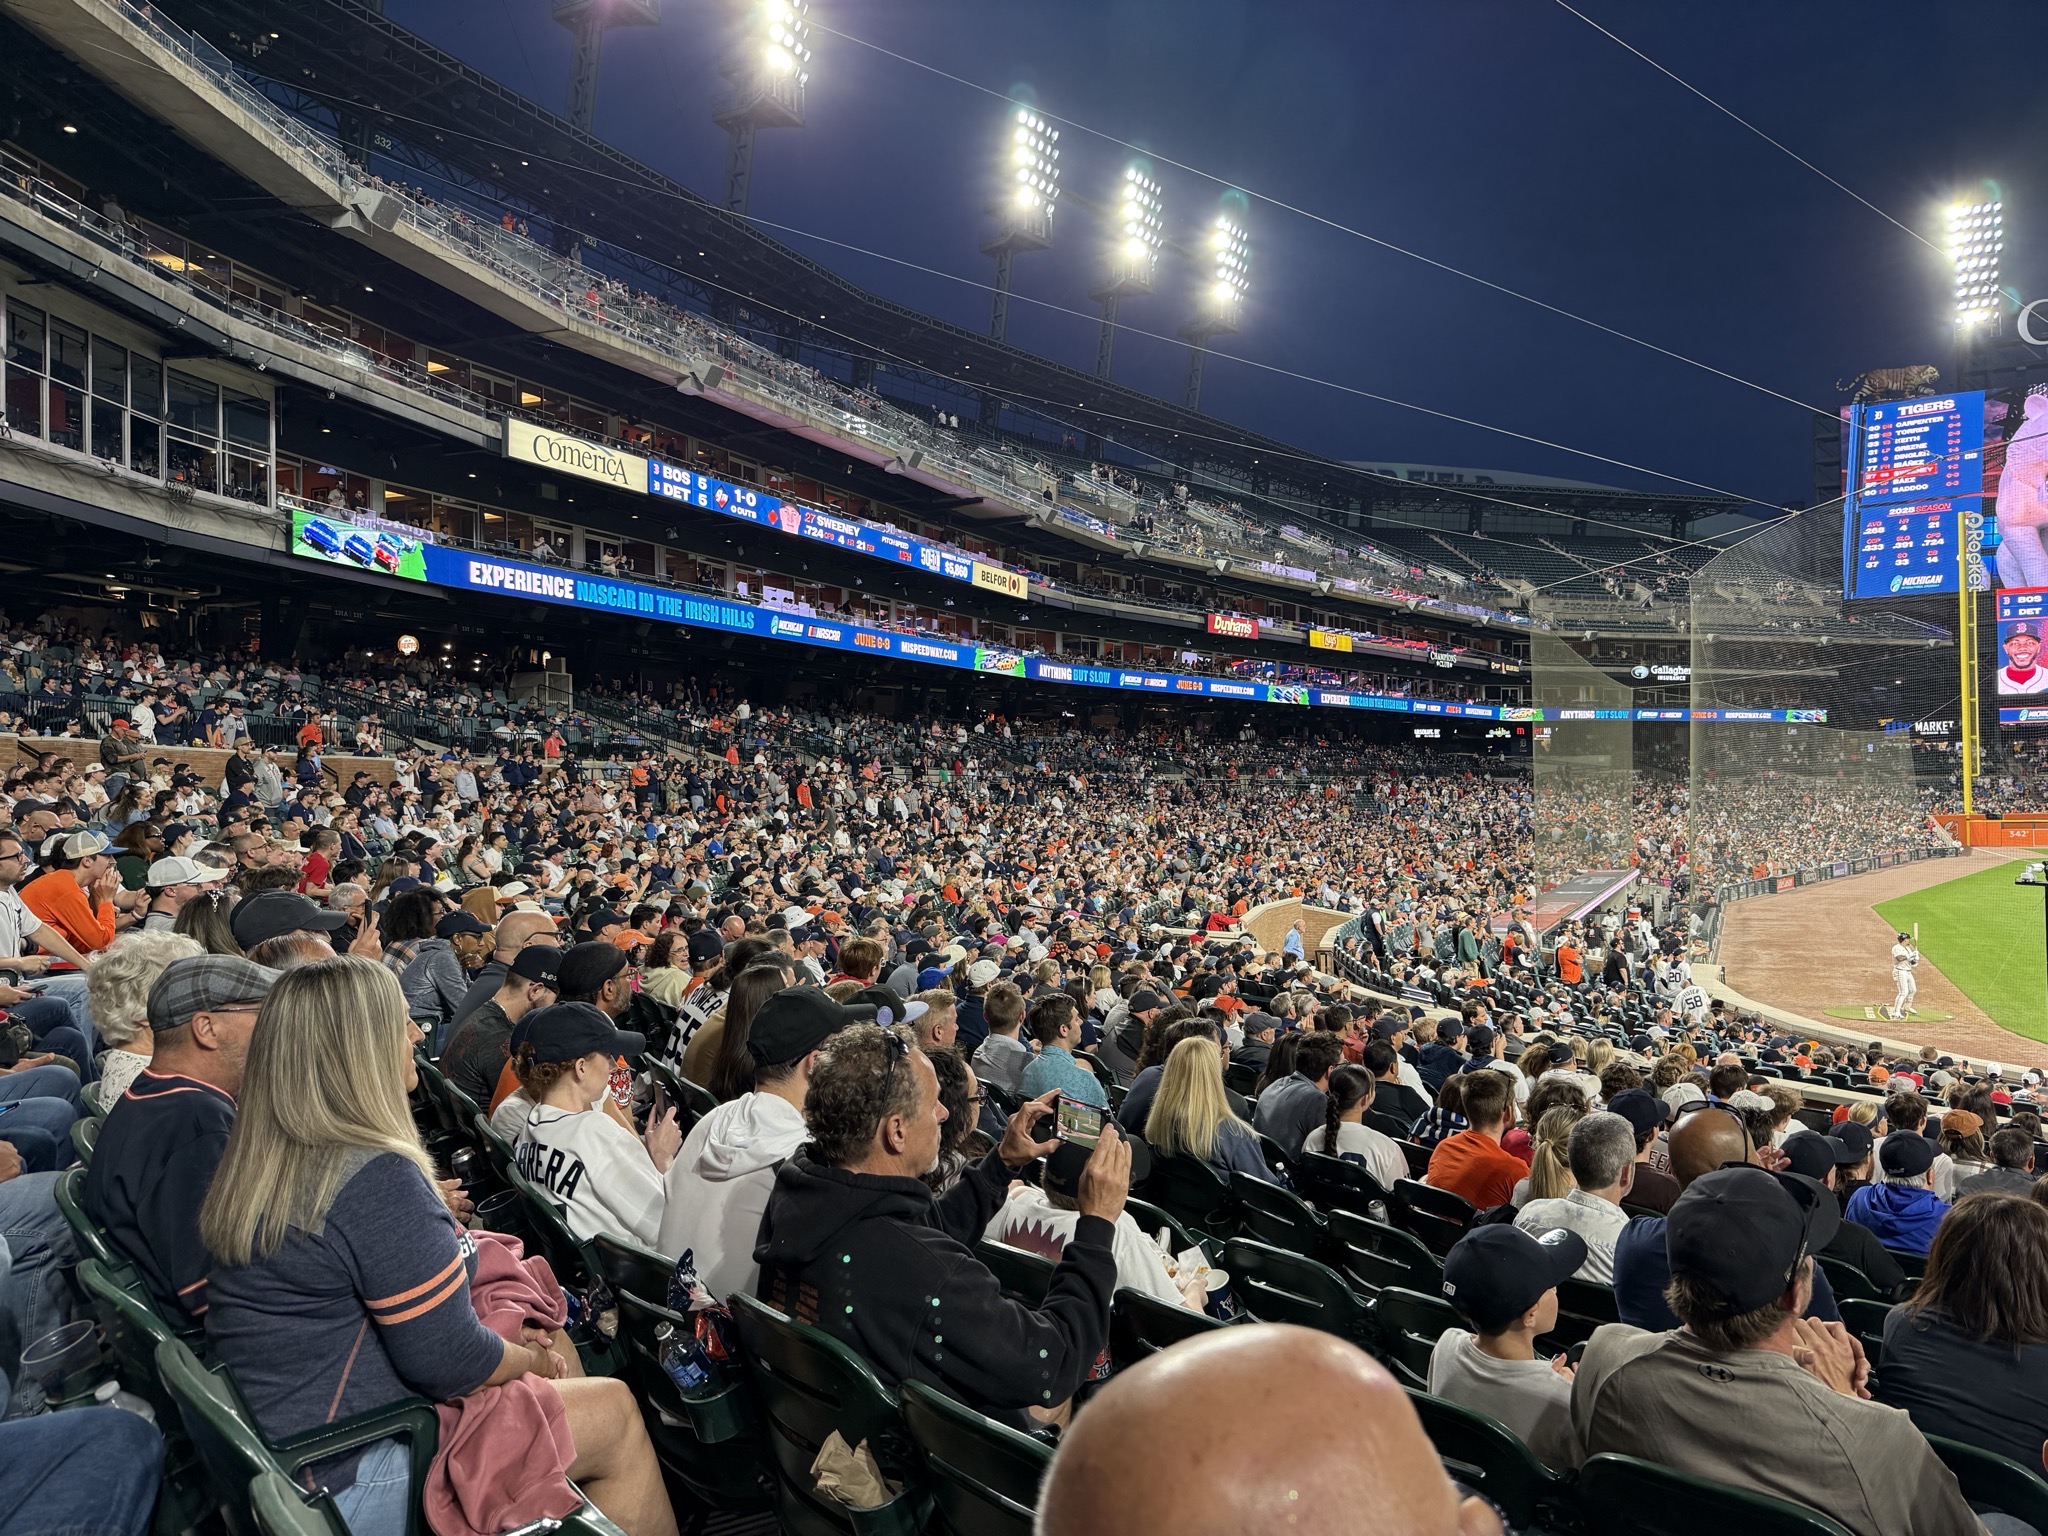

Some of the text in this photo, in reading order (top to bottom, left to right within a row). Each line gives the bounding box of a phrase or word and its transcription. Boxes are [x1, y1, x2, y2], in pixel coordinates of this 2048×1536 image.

[374, 134, 392, 150] 332
[1898, 399, 1955, 416] TIGERS
[1896, 416, 1944, 428] CARPENTER
[1895, 426, 1930, 436] TORRES
[1895, 435, 1920, 444] KEITH
[1894, 443, 1928, 452] GREENE
[663, 465, 691, 485] BOS
[697, 477, 708, 490] 5
[663, 482, 691, 501] DET
[698, 494, 708, 506] 5
[1892, 484, 1929, 493] BADDOO
[734, 488, 757, 507] 1-0
[737, 506, 757, 519] OUTS
[1889, 503, 1951, 515] 2025 SEASON
[804, 512, 860, 537] 27 SWEENEY
[804, 525, 824, 539] .724
[837, 535, 845, 545] 4
[856, 540, 866, 551] 21
[881, 536, 909, 550] PITCH SPEED
[899, 551, 912, 561] MPH
[981, 570, 1007, 587] BELFOR
[1902, 575, 1943, 586] MICHIGAN
[469, 560, 755, 630] EXPERIENCE NASCAR IN THE IRISH HILLS
[2018, 595, 2043, 603] BOS
[2018, 607, 2043, 615] DET
[778, 619, 804, 633] MICHIGAN
[1214, 615, 1252, 634] Dunham's
[816, 627, 841, 642] NASCAR
[854, 632, 876, 648] JUNE
[901, 641, 958, 661] MISPEEDWAY.COM
[1430, 651, 1457, 664] CHAMPIONS
[1039, 664, 1110, 684] ANYTHING BUT SLOW
[1176, 680, 1192, 690] JUNE
[1321, 693, 1350, 706] EXPERIENCE
[1560, 710, 1629, 719] ANYTHING BUT SLOW
[1915, 720, 1954, 732] MARKET
[1669, 972, 1681, 982] 20
[1685, 995, 1704, 1010] 58
